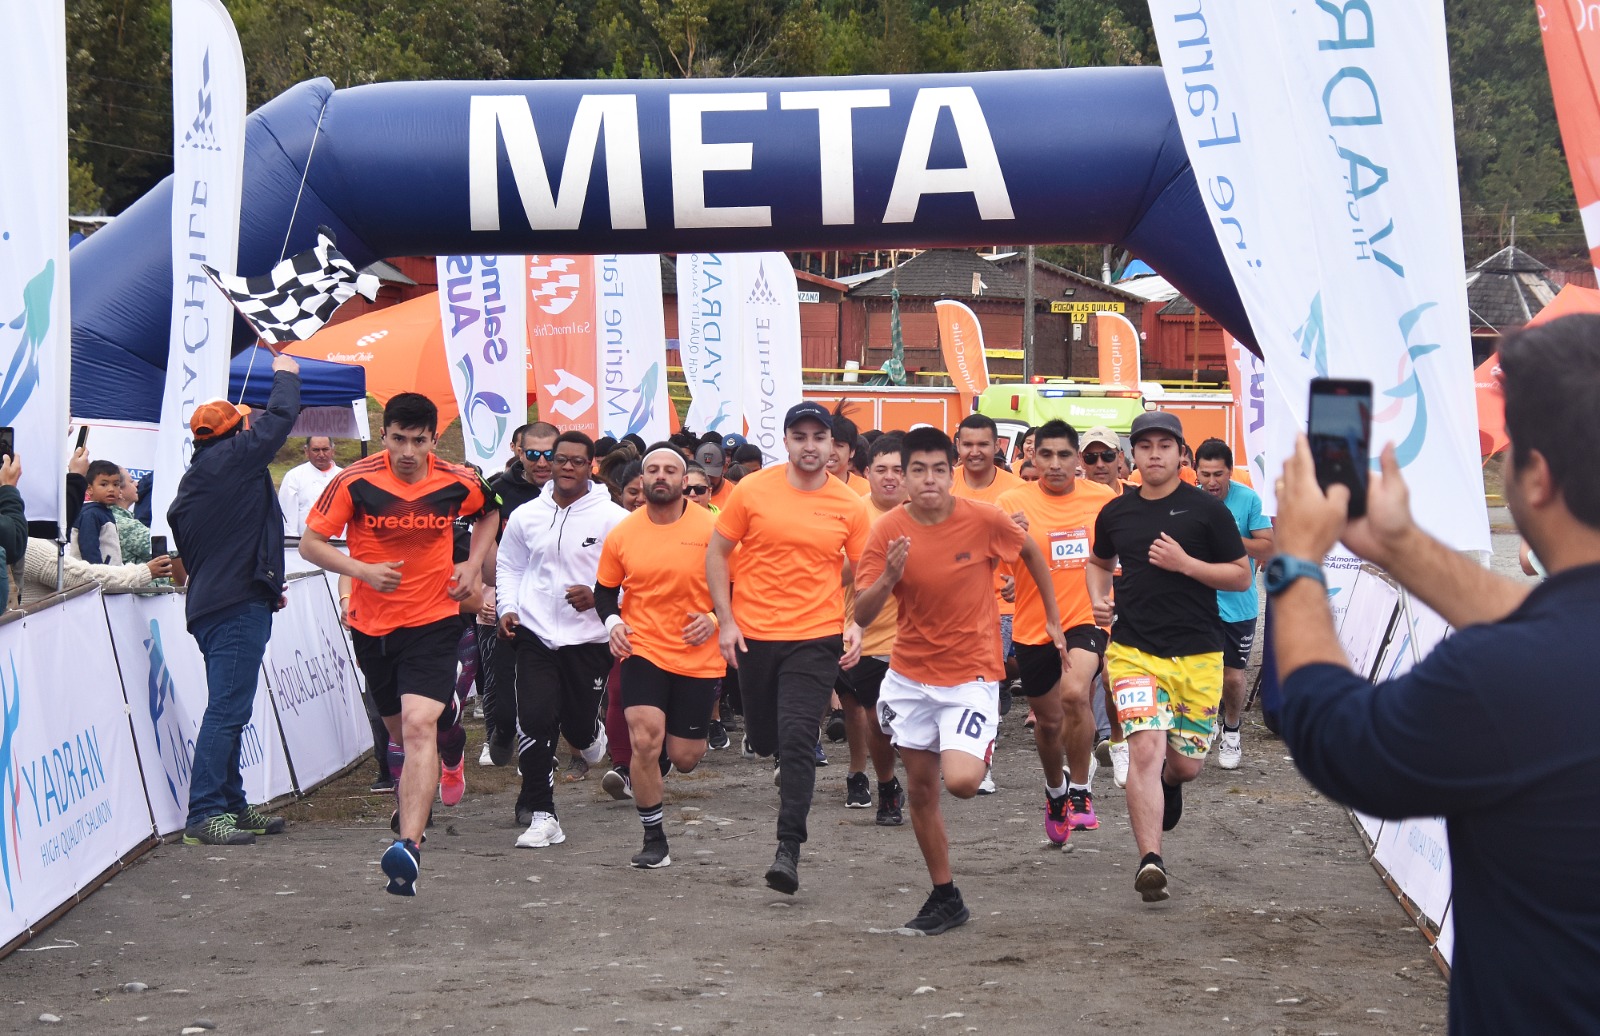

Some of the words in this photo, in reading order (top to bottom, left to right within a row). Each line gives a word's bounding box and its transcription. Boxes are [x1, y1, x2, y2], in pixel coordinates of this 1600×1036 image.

[469, 86, 1016, 231] META
[1076, 303, 1090, 312] LAS
[1091, 303, 1118, 312] QUILAS
[327, 351, 375, 363] SalmonChile
[364, 512, 453, 530] predator
[1056, 543, 1084, 556] 024
[1324, 554, 1363, 564] Salmones
[270, 649, 335, 717] AQUACHILE
[1119, 691, 1147, 706] 012
[956, 708, 987, 739] 16
[21, 725, 105, 828] YADRAN
[40, 836, 61, 868] HIGH
[60, 815, 87, 859] QUALITY
[84, 798, 113, 836] SALMON
